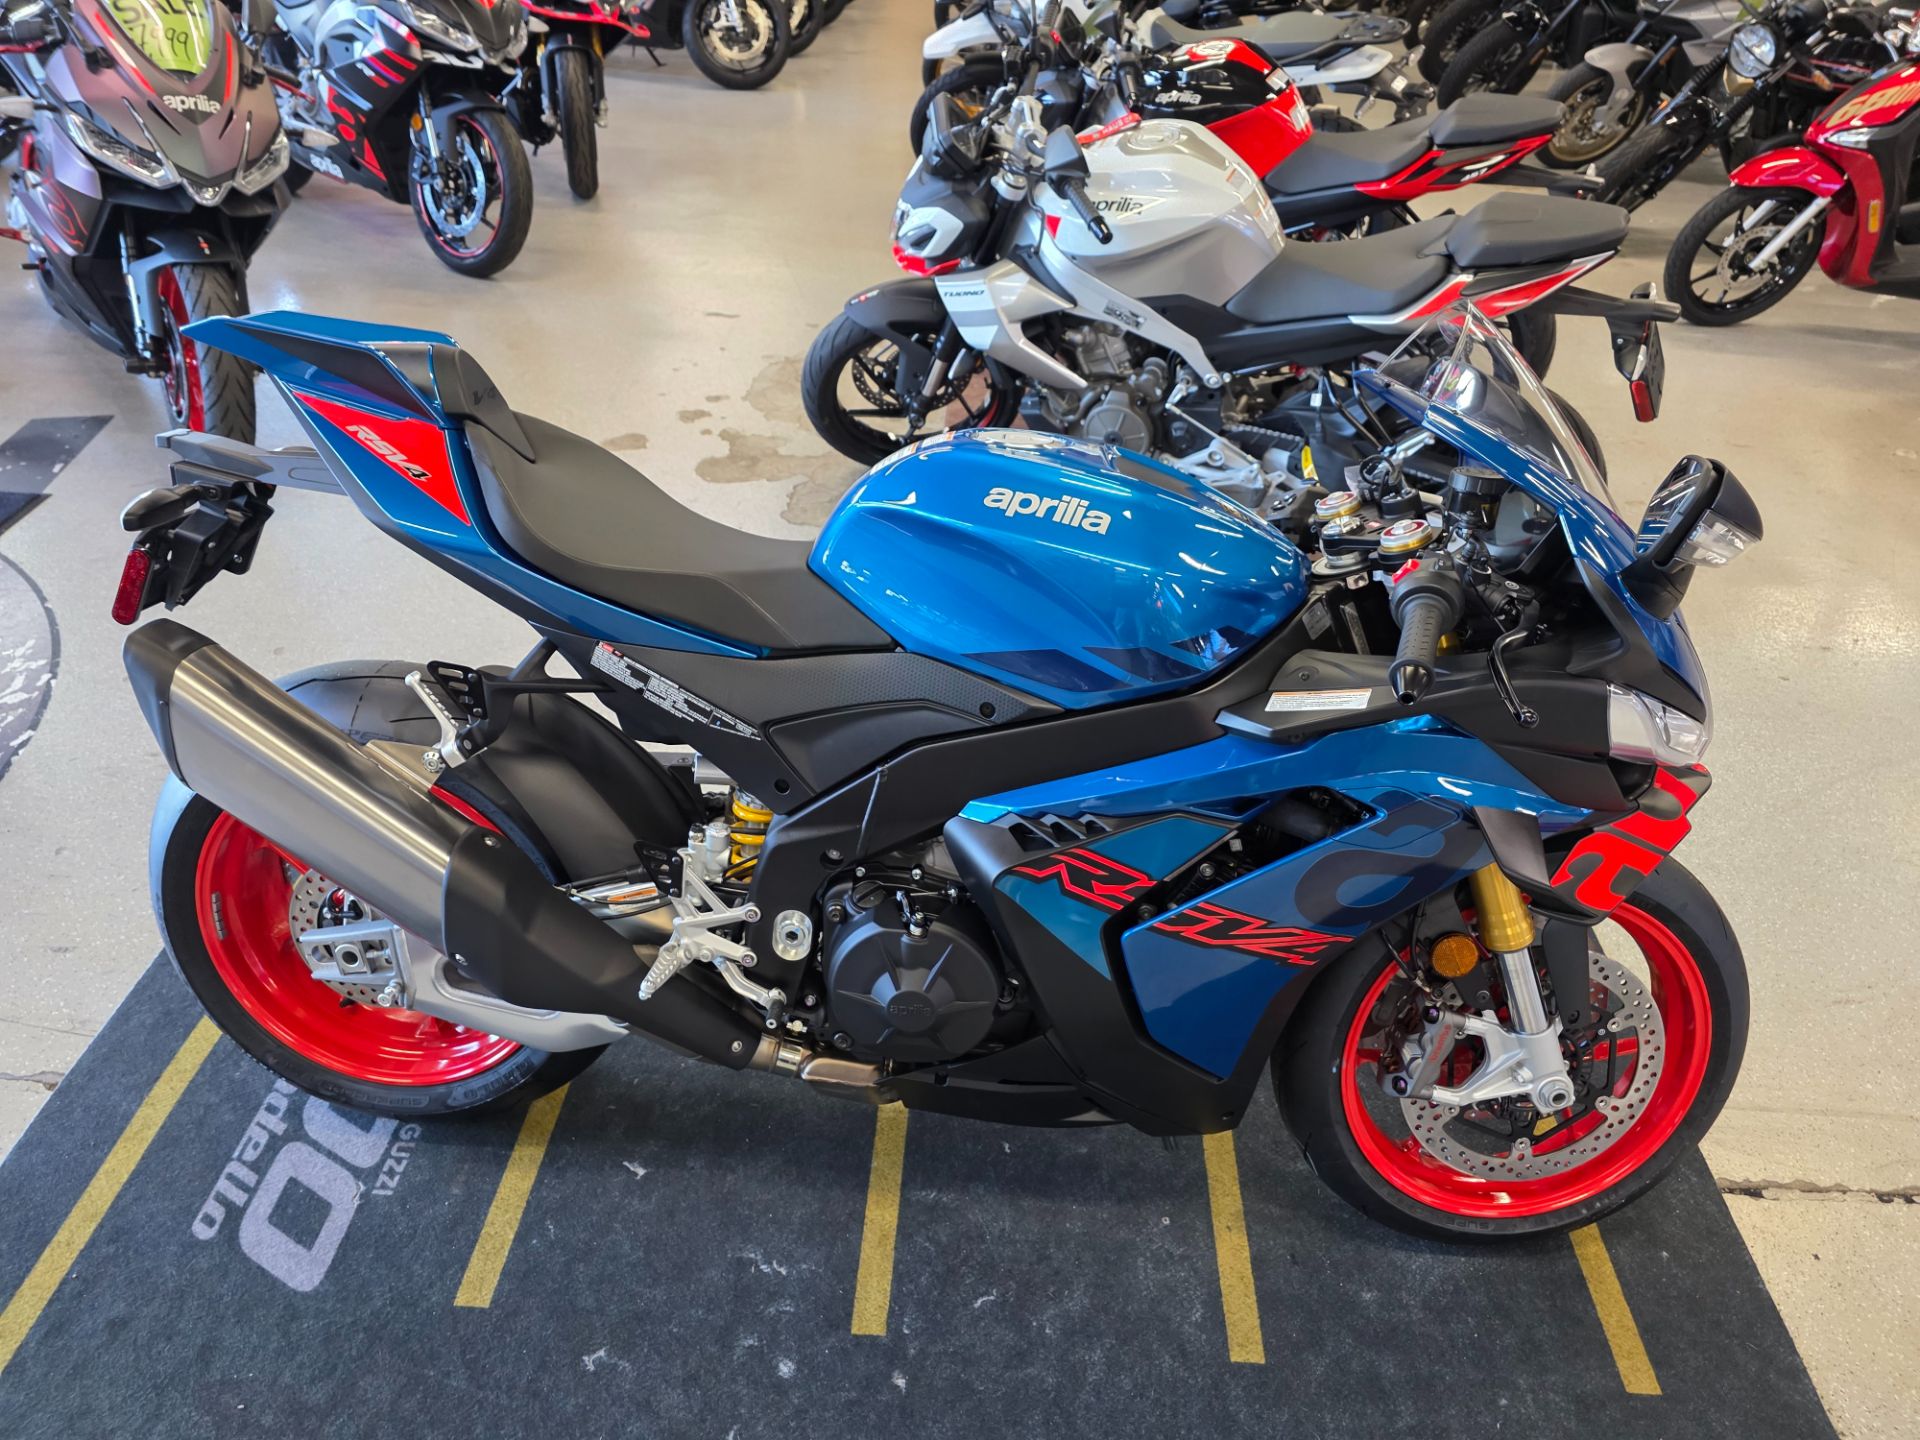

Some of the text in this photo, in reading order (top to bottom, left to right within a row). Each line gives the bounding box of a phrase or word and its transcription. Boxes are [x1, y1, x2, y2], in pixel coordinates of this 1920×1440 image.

[162, 93, 221, 114] aprilia
[1155, 89, 1202, 105] aprilia
[1092, 196, 1144, 215] prilia
[345, 424, 432, 483] RSV4
[983, 486, 1112, 536] aprilia
[190, 1077, 299, 1241] dello
[371, 1122, 423, 1196] GUZZI
